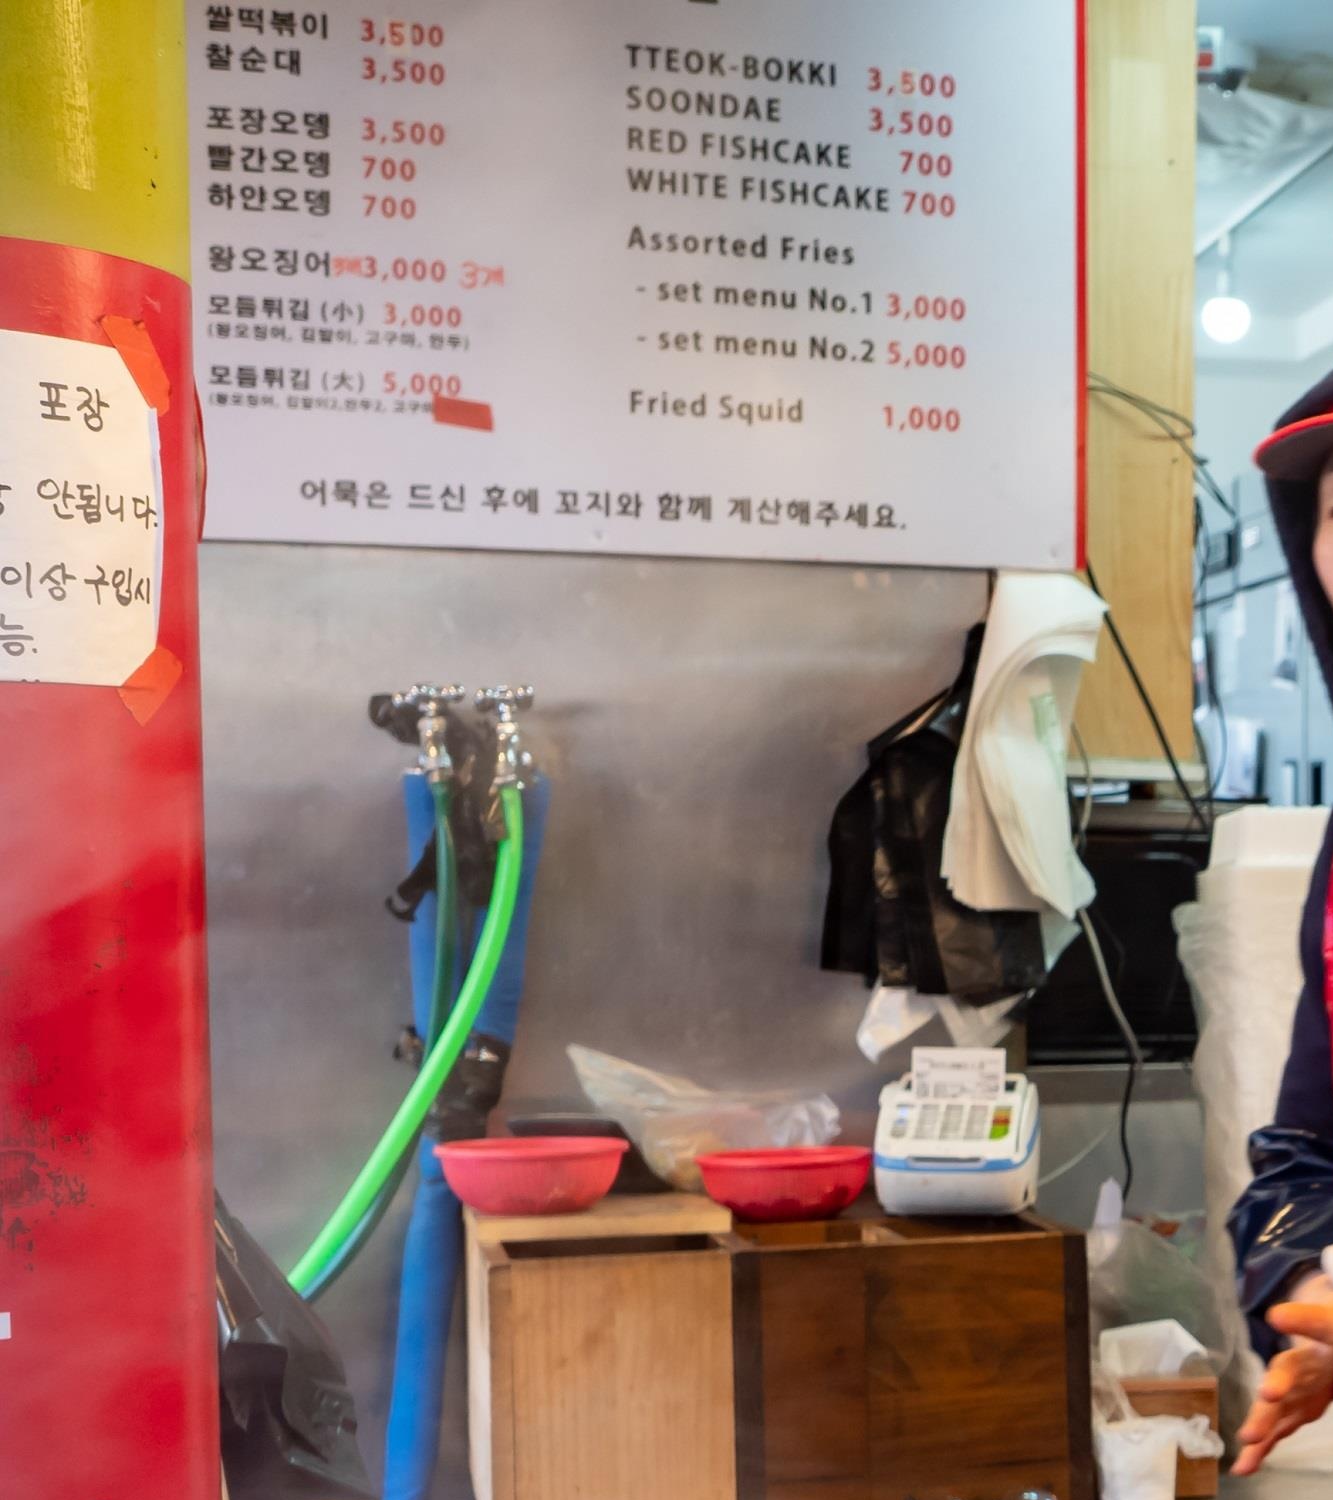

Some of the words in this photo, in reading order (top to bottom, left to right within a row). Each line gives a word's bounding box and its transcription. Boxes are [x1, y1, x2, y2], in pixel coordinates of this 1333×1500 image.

[205, 5, 329, 40] 쌀떡볶이
[360, 19, 444, 48] 3,500
[205, 43, 302, 76] 찰순대
[361, 58, 445, 87] 3,500
[626, 44, 837, 87] TTEOK-BOKKI
[866, 67, 957, 98] 3,500
[206, 107, 331, 140] 포장오뎅
[361, 118, 446, 147] 3,500
[626, 86, 782, 121] SOONDAE
[868, 108, 953, 138] 3,500
[207, 144, 331, 178] 빨간오뎅
[362, 156, 416, 183] 700
[627, 126, 687, 154] RED
[700, 132, 852, 169] FISHCAKE
[899, 151, 952, 177] 700
[362, 195, 416, 220] 700
[627, 168, 728, 198] WHITE
[741, 177, 890, 213] FISHCAKE
[903, 192, 956, 217] 700
[208, 245, 331, 278] 왕오징어
[361, 255, 446, 284] 3,000
[627, 225, 768, 259] Assorted
[780, 237, 855, 266] Fries
[384, 302, 462, 328] 3,000
[658, 281, 703, 304] set
[714, 285, 797, 311] menu
[809, 288, 873, 315] No.1
[885, 293, 966, 322] 3,000
[658, 330, 703, 353] set
[714, 334, 797, 359] menu
[809, 337, 875, 364] No.2
[886, 341, 966, 370] 5,000
[383, 371, 462, 397] 5,000
[39, 381, 110, 432] 포장
[629, 390, 707, 418] Fried
[719, 394, 804, 426] Squid
[882, 404, 960, 433] 1,000
[37, 478, 158, 530] 안됩니다.
[300, 480, 391, 512] 어묵은
[408, 484, 465, 513] 드신
[481, 486, 539, 516] 후에
[555, 489, 642, 520] 꼬지와
[658, 492, 712, 523] 함께
[727, 496, 907, 531] 계산해주세요.
[1, 561, 76, 602] 이상
[84, 565, 151, 606] 구입시
